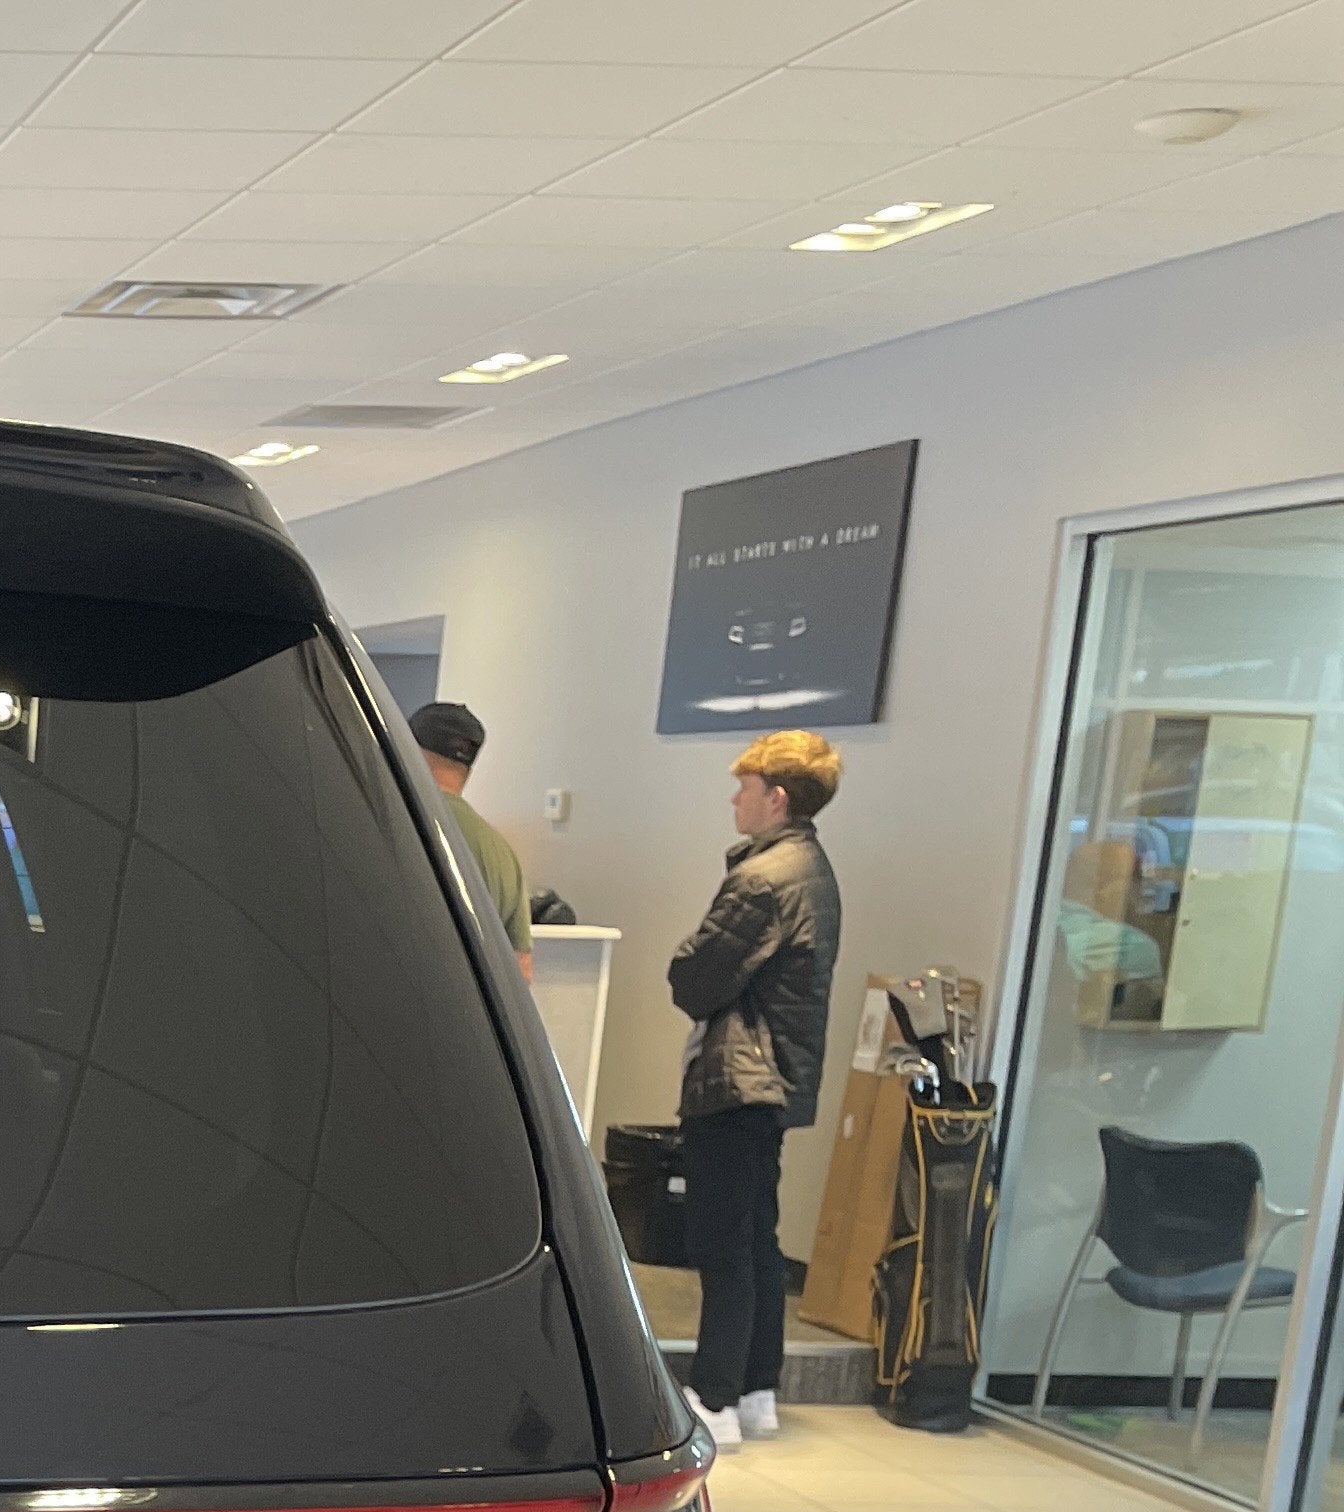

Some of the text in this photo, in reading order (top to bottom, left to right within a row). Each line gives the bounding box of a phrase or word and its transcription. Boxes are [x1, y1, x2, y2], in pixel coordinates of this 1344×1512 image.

[706, 551, 727, 566] ALL
[733, 540, 777, 563] STARTS
[782, 534, 815, 553] WITH
[820, 531, 829, 546] A
[835, 522, 880, 545] DREAM
